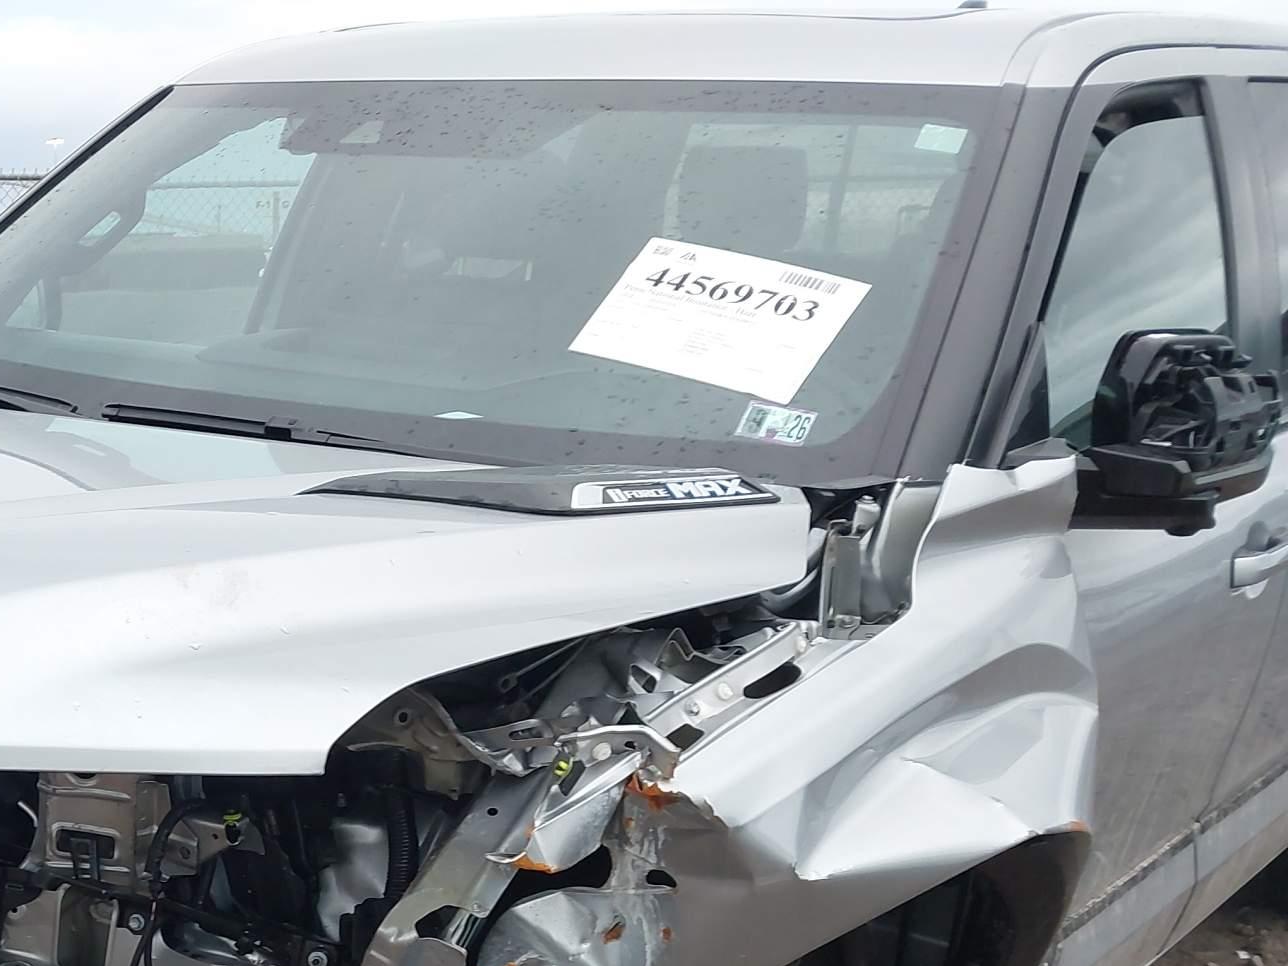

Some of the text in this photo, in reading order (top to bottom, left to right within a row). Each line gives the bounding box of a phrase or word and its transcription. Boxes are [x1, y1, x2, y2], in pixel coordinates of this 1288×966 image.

[645, 268, 819, 322] 44569703
[787, 414, 812, 440] 26
[666, 478, 754, 499] MAX
